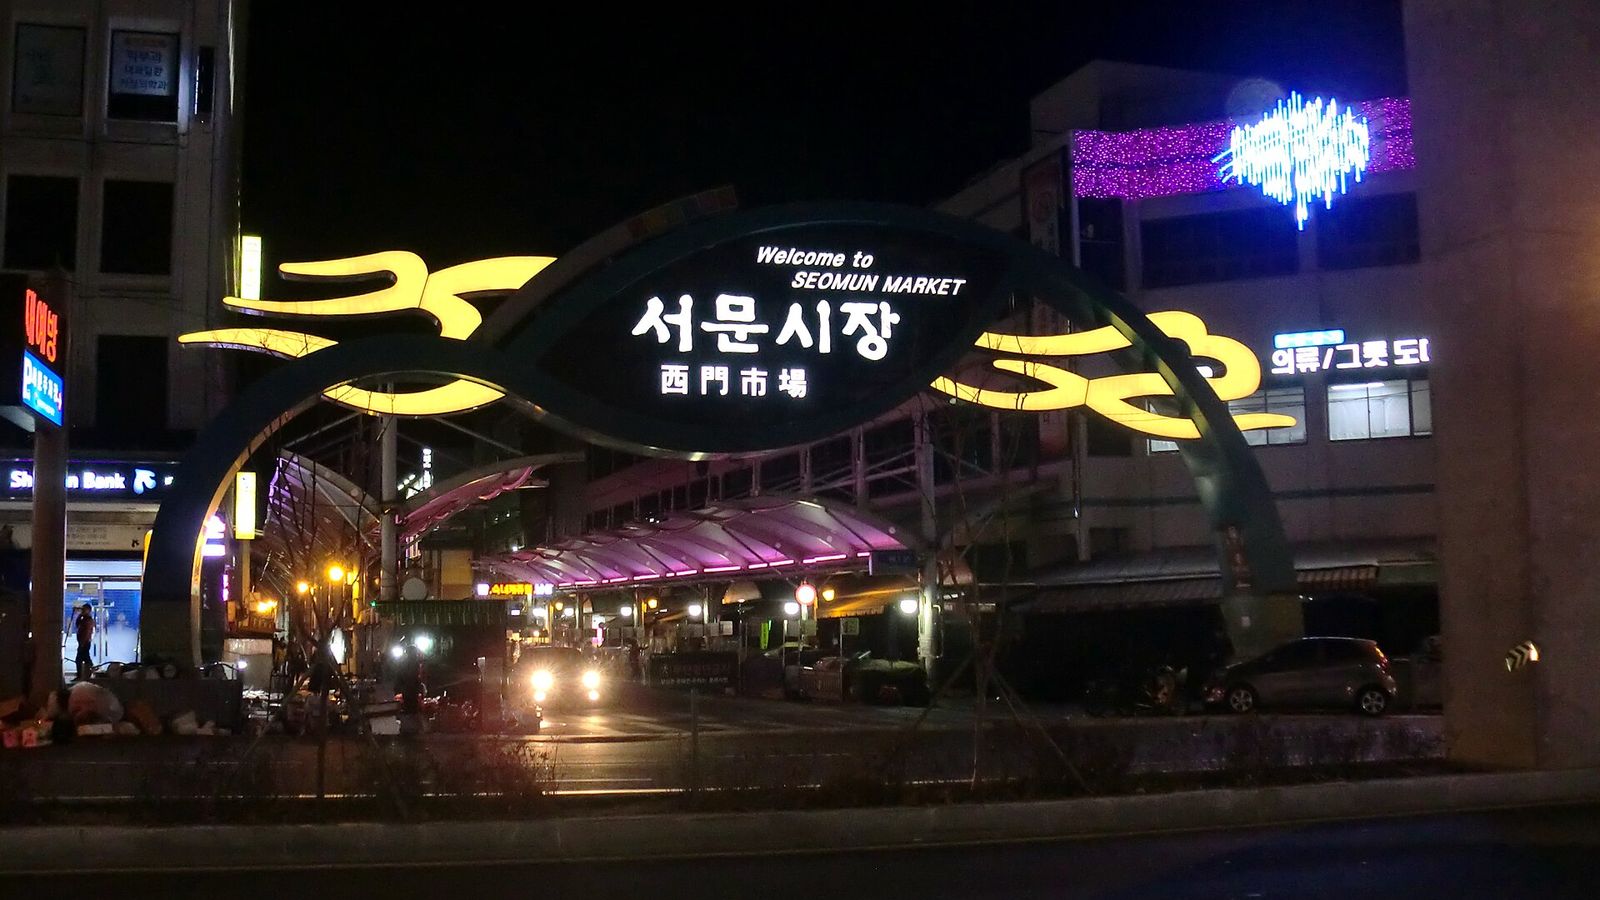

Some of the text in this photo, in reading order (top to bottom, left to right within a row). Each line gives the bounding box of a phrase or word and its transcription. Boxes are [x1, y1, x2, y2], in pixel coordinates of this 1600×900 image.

[756, 246, 875, 269] Welcome to
[791, 271, 967, 296] SEOMUN MARKET
[631, 293, 901, 361] 서문시장
[660, 364, 809, 399] 西門市場
[83, 470, 126, 489] Bank
